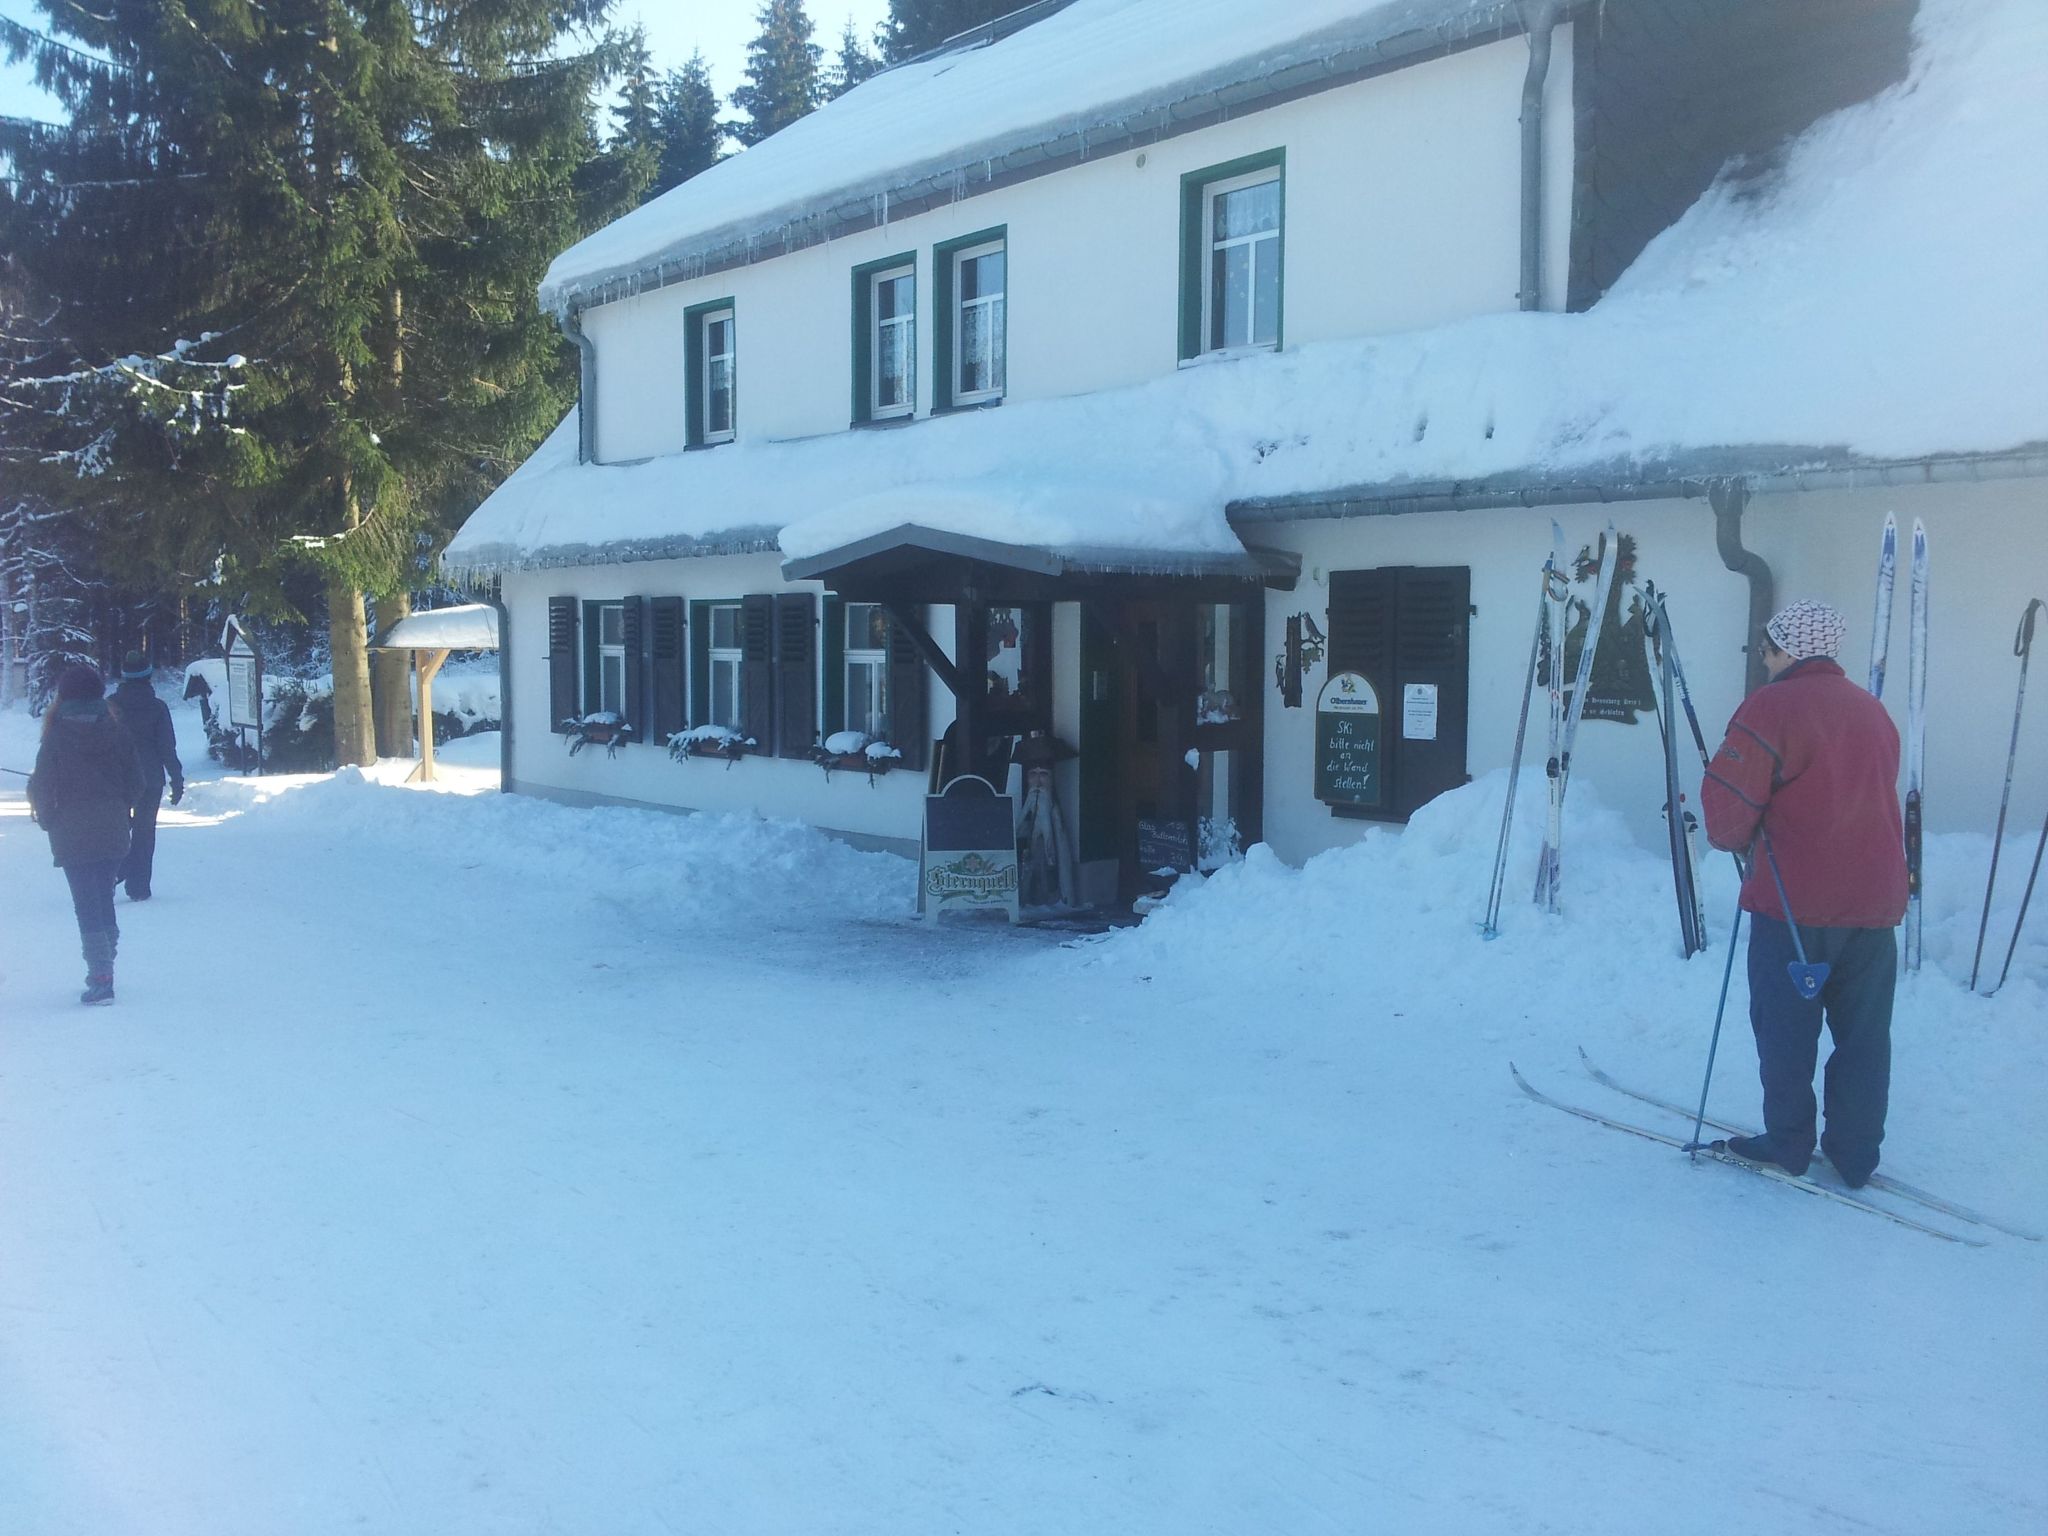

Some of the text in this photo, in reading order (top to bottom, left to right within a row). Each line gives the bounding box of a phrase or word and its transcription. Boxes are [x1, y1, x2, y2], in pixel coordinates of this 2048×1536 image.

[1329, 737, 1375, 752] bitte nicht
[1340, 752, 1351, 760] an
[1326, 760, 1369, 773] die Wand
[929, 867, 1017, 893] Sternquell
